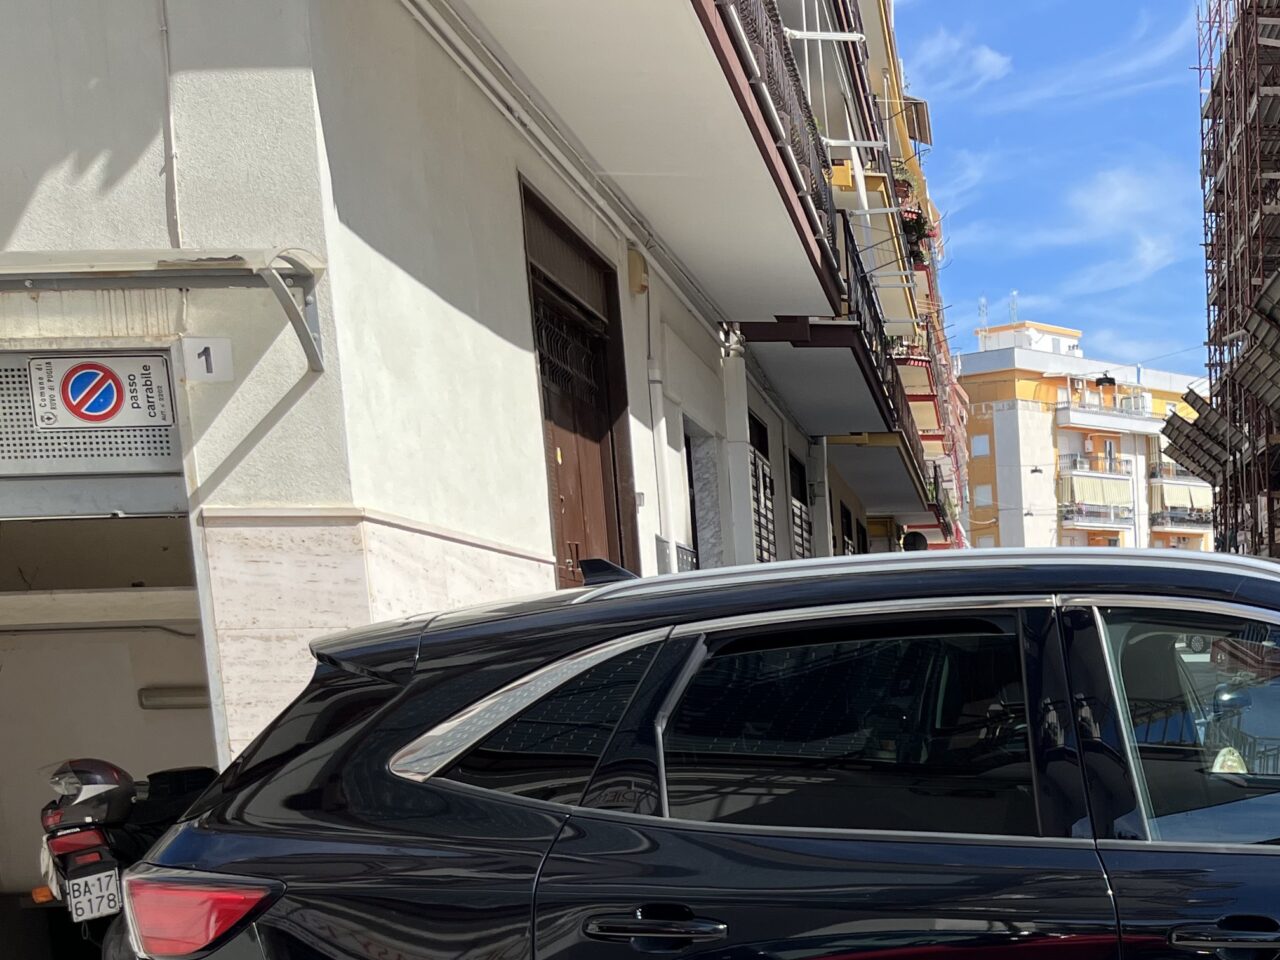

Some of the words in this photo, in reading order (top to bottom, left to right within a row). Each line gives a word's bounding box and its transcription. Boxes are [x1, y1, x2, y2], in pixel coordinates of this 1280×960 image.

[34, 363, 43, 371] di
[44, 361, 56, 383] PUGLIA
[197, 346, 213, 374] 1
[38, 376, 48, 408] Comune
[47, 382, 56, 391] di
[127, 373, 142, 409] passo
[140, 364, 157, 418] carrabile
[48, 393, 57, 410] RUVO
[71, 880, 92, 899] BA
[96, 874, 114, 893] 17
[74, 893, 117, 917] 6178
